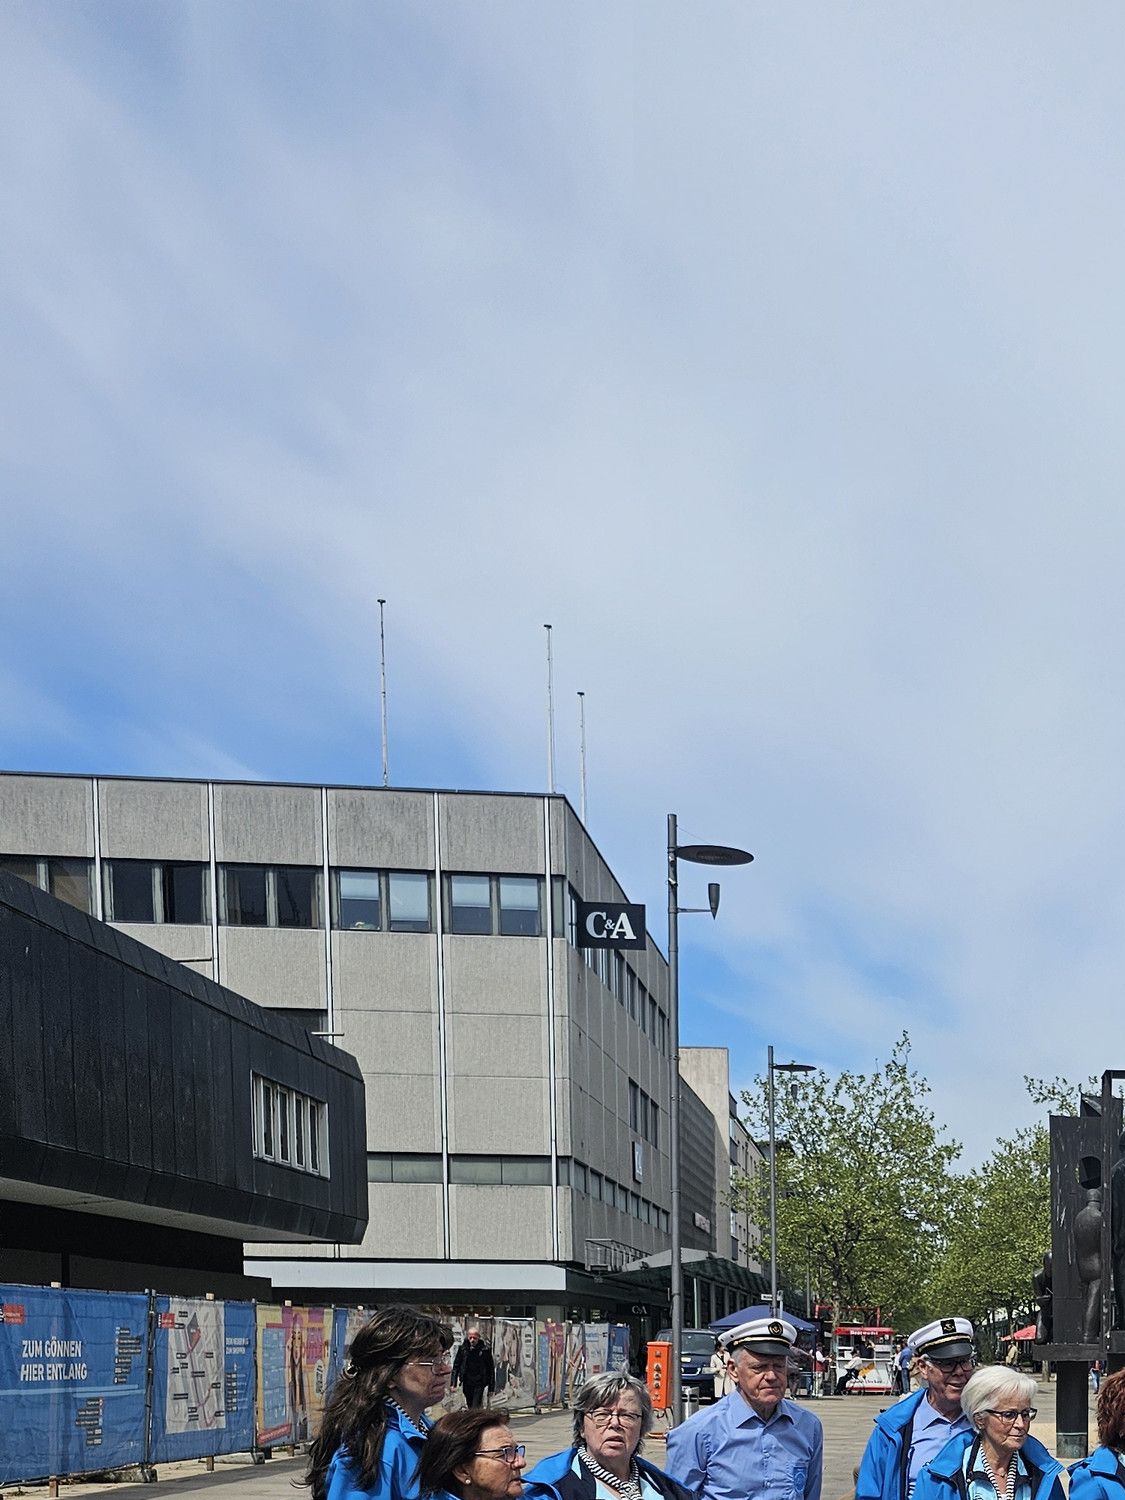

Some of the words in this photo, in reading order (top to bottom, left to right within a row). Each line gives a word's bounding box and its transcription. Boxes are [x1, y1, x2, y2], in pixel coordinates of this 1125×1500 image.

[586, 911, 637, 940] C&A
[22, 1340, 42, 1358] ZUM
[44, 1336, 82, 1358] GÖNNEN
[20, 1364, 45, 1381] HIER
[46, 1362, 88, 1381] ENTLANG
